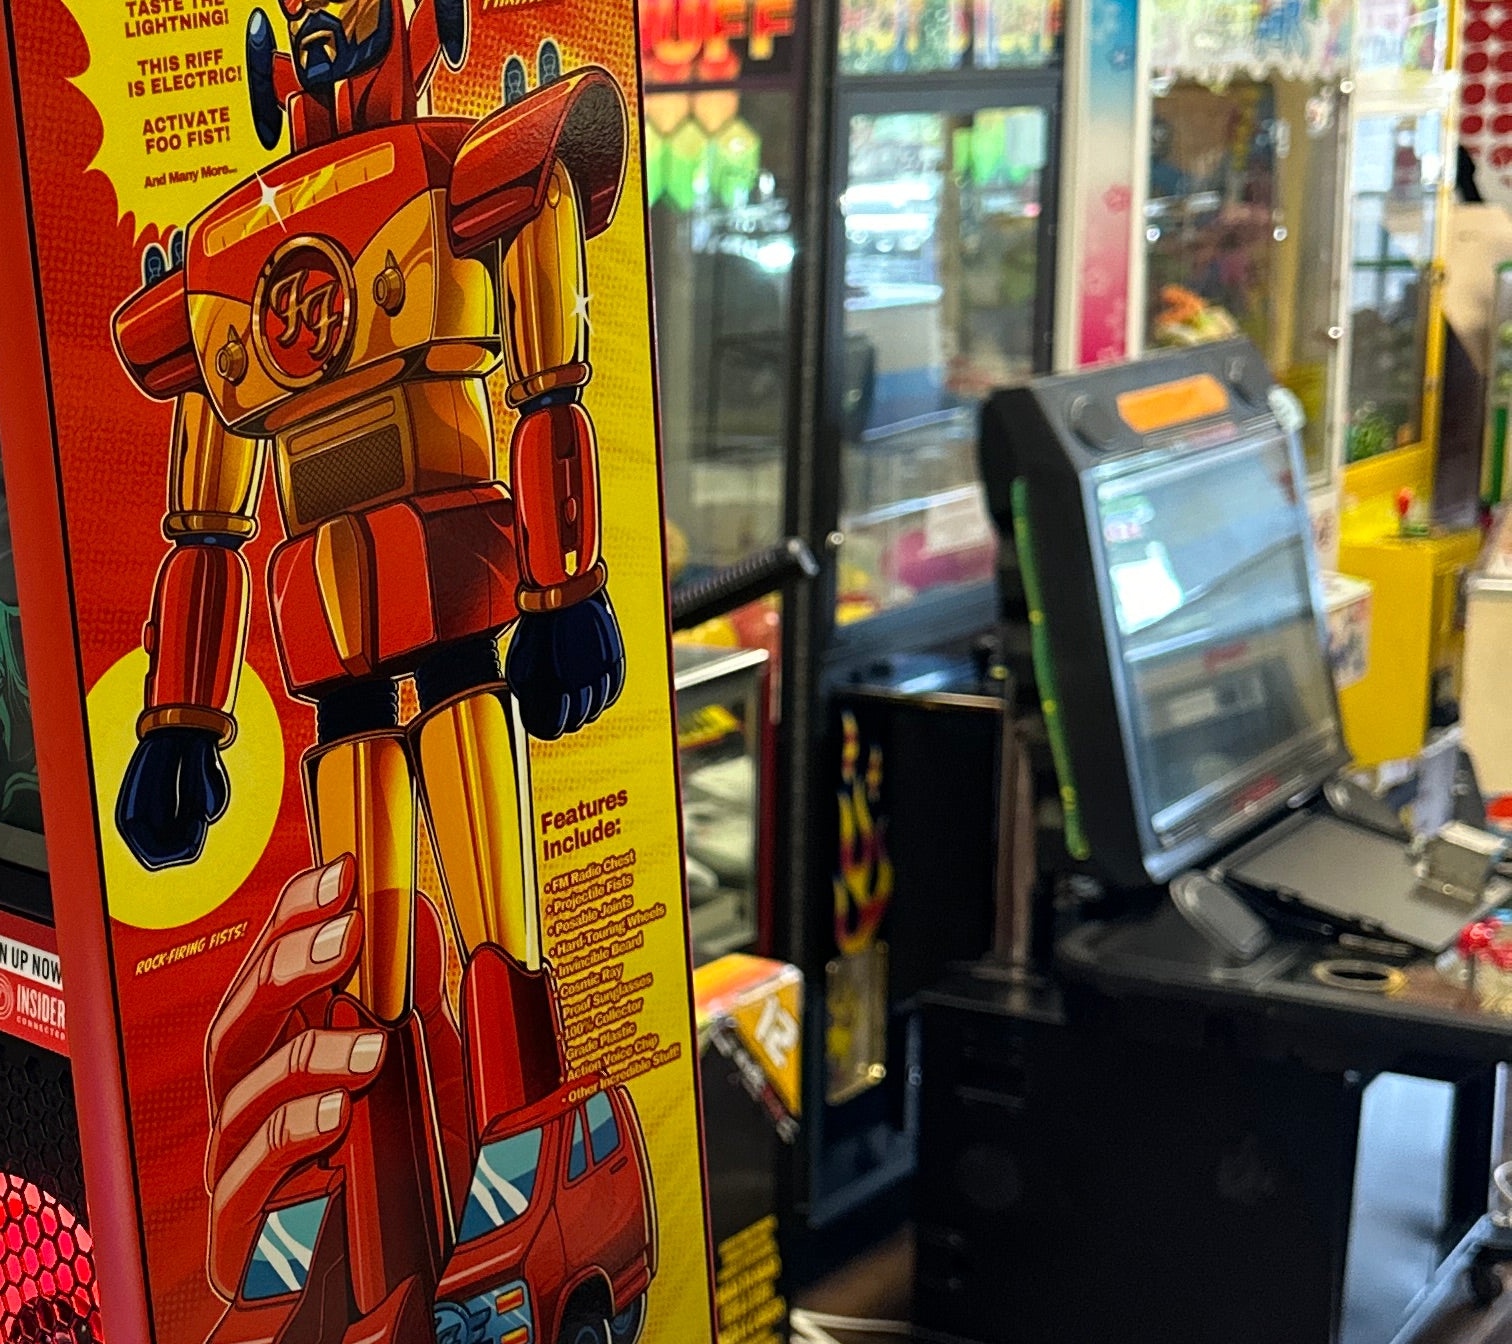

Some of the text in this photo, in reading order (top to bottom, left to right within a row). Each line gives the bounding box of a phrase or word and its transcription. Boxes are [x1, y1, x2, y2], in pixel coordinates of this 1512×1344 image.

[124, 8, 229, 39] LIGHTNING!
[137, 48, 223, 76] THIS RIFF
[128, 65, 242, 98] IS ELECTRIC!
[142, 106, 231, 136] ACTIVATE
[145, 125, 230, 155] FOO FIST!
[144, 164, 238, 189] And Many More...
[541, 788, 628, 835] Features
[542, 817, 621, 862] Include:
[552, 850, 635, 892] FM Radio Chest
[554, 874, 633, 913] Projectile Fists
[555, 896, 633, 935] Posable Joints
[627, 903, 666, 928] Wheels
[11, 948, 29, 972] UP
[31, 954, 61, 986] NOW
[135, 921, 248, 976] ROCK-FIRING FISTS!
[559, 948, 610, 977] Invincible
[560, 964, 623, 997] Cosmic Ray
[563, 973, 653, 1018] Proof Sunglasses
[16, 983, 66, 1030] INSIDER
[565, 998, 644, 1040] 100% Collector
[566, 1022, 636, 1060] Grade Plastic
[567, 1034, 659, 1082] Action Voice Chip
[568, 1084, 597, 1103] Other
[600, 1059, 651, 1090] Incredible
